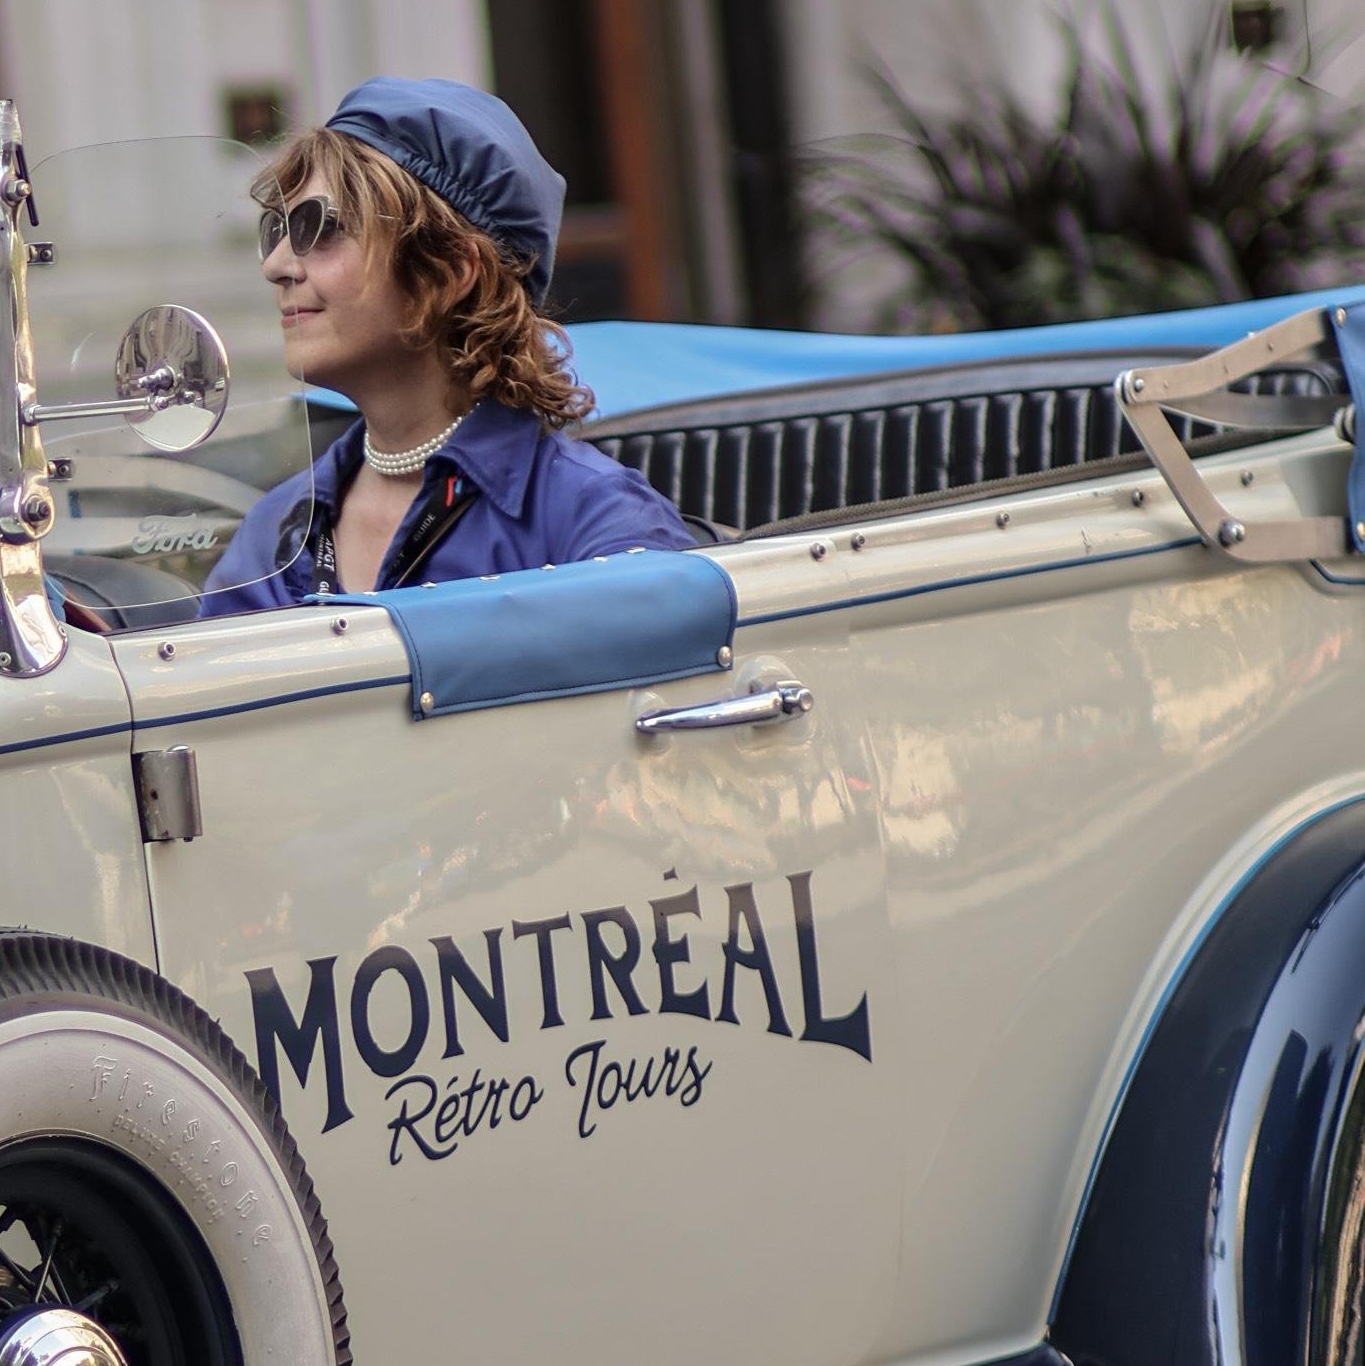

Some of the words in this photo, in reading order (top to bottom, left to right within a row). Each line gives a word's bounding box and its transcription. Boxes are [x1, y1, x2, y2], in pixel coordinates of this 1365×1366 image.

[131, 512, 219, 554] Ford
[243, 867, 873, 1134] MONTRÉAL
[88, 1054, 273, 1247] Firestone
[385, 1068, 544, 1166] Rétro
[564, 1039, 713, 1138] Tours
